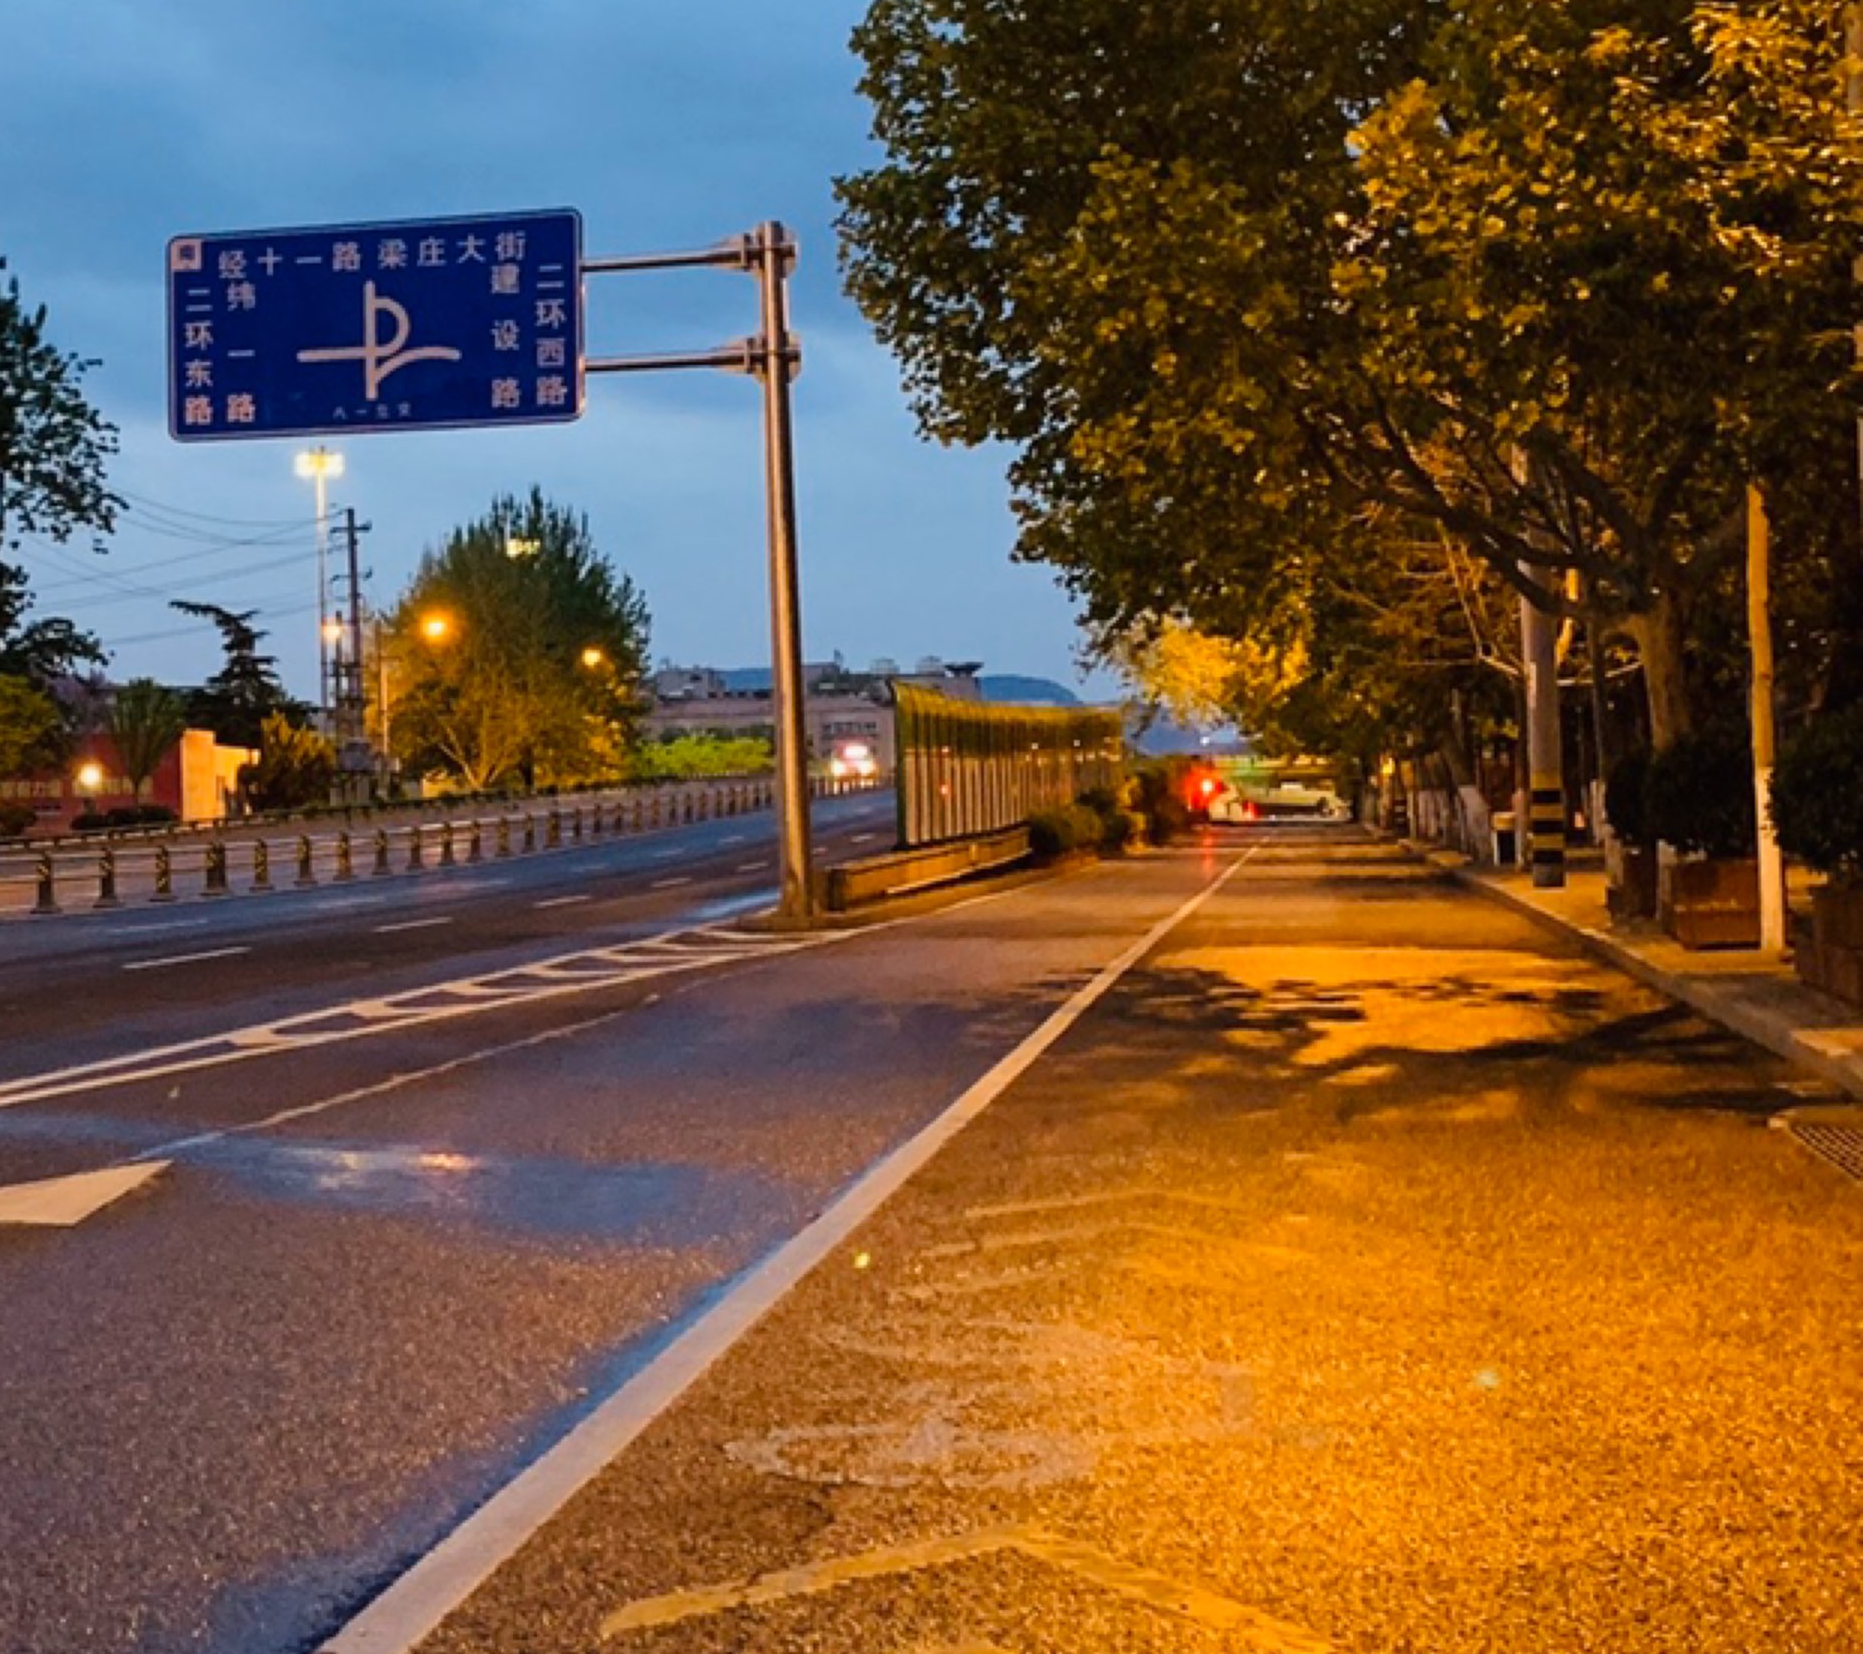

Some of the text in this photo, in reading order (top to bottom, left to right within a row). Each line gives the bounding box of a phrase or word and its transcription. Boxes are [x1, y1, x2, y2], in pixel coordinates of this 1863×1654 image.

[218, 230, 526, 279] 经十一路 梁庄大街
[184, 288, 214, 426] 二环东路
[227, 280, 256, 423] 纬一路
[491, 263, 521, 408] 建设路
[535, 265, 567, 405] 二环西路
